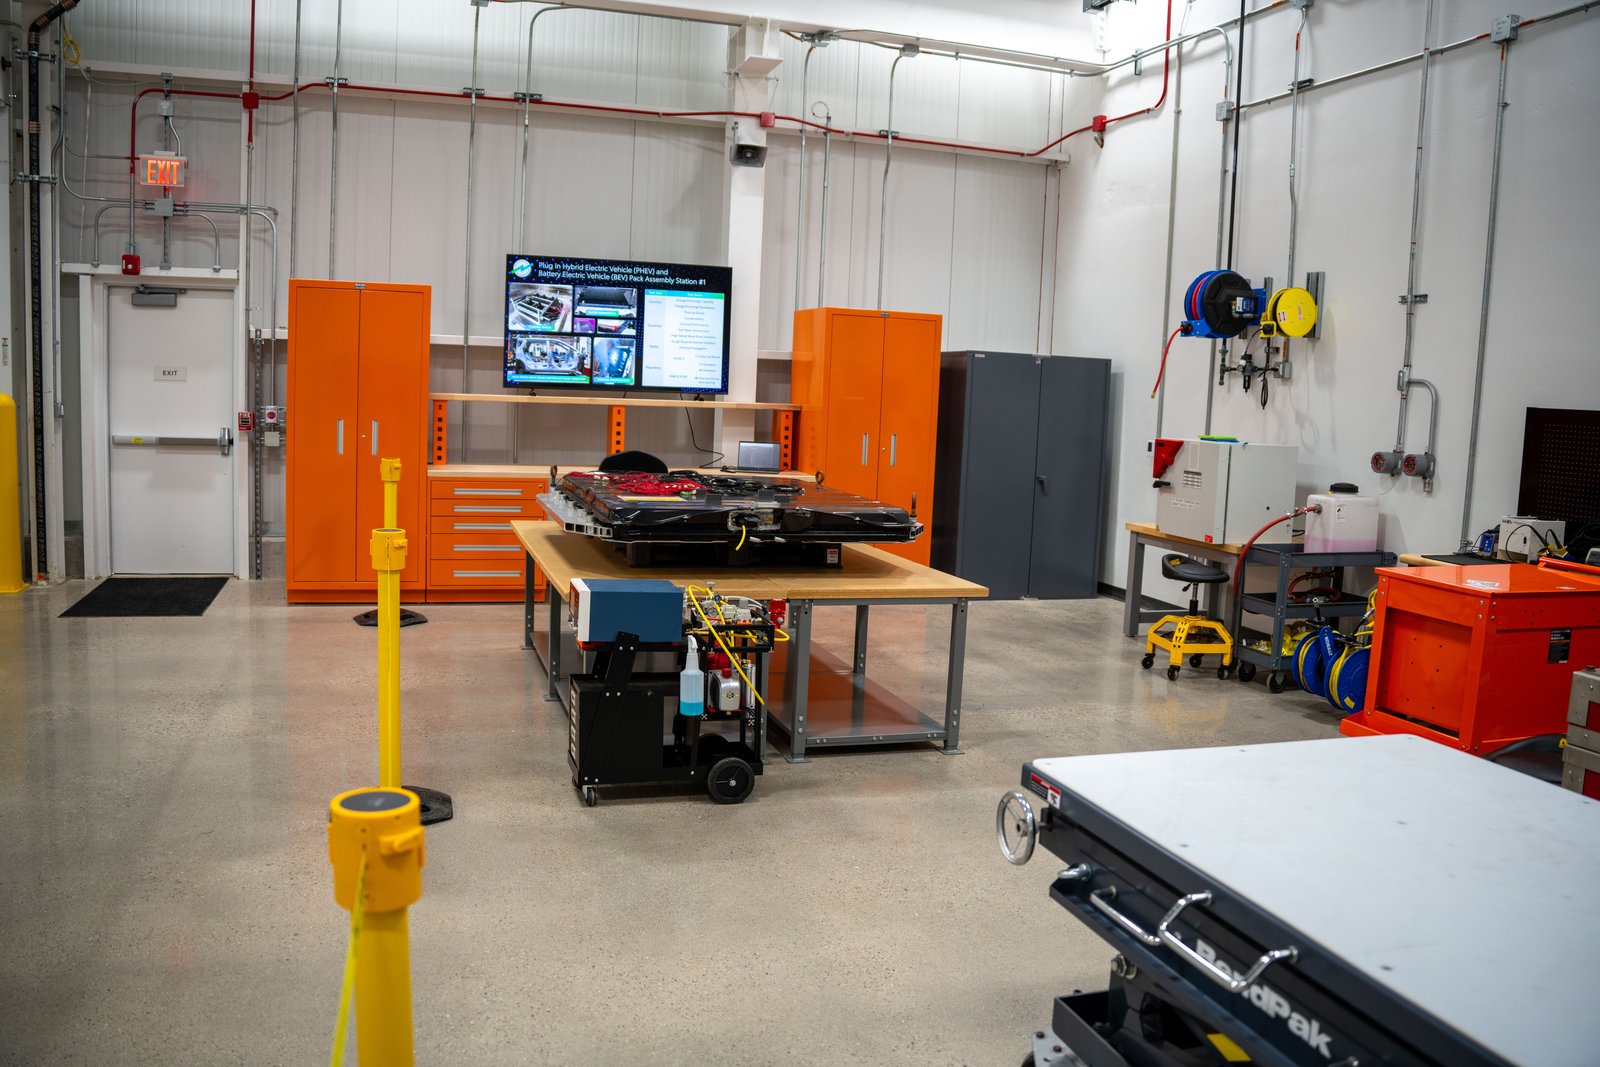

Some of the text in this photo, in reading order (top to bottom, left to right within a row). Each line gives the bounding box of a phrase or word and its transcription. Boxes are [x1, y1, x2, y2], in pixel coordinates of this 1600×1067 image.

[147, 159, 179, 185] EXIT
[538, 262, 553, 270] Plug
[562, 263, 584, 271] Hybrid
[585, 264, 608, 272] Electric
[609, 265, 632, 273] Vehicle
[633, 266, 655, 275] (PHEV)
[538, 270, 562, 279] Battery
[562, 271, 586, 279] Electric
[586, 272, 610, 280] Vehicle
[611, 273, 628, 281] (BEV)
[628, 274, 644, 282] Pack
[644, 275, 675, 284] Assembly
[675, 277, 698, 285] Station
